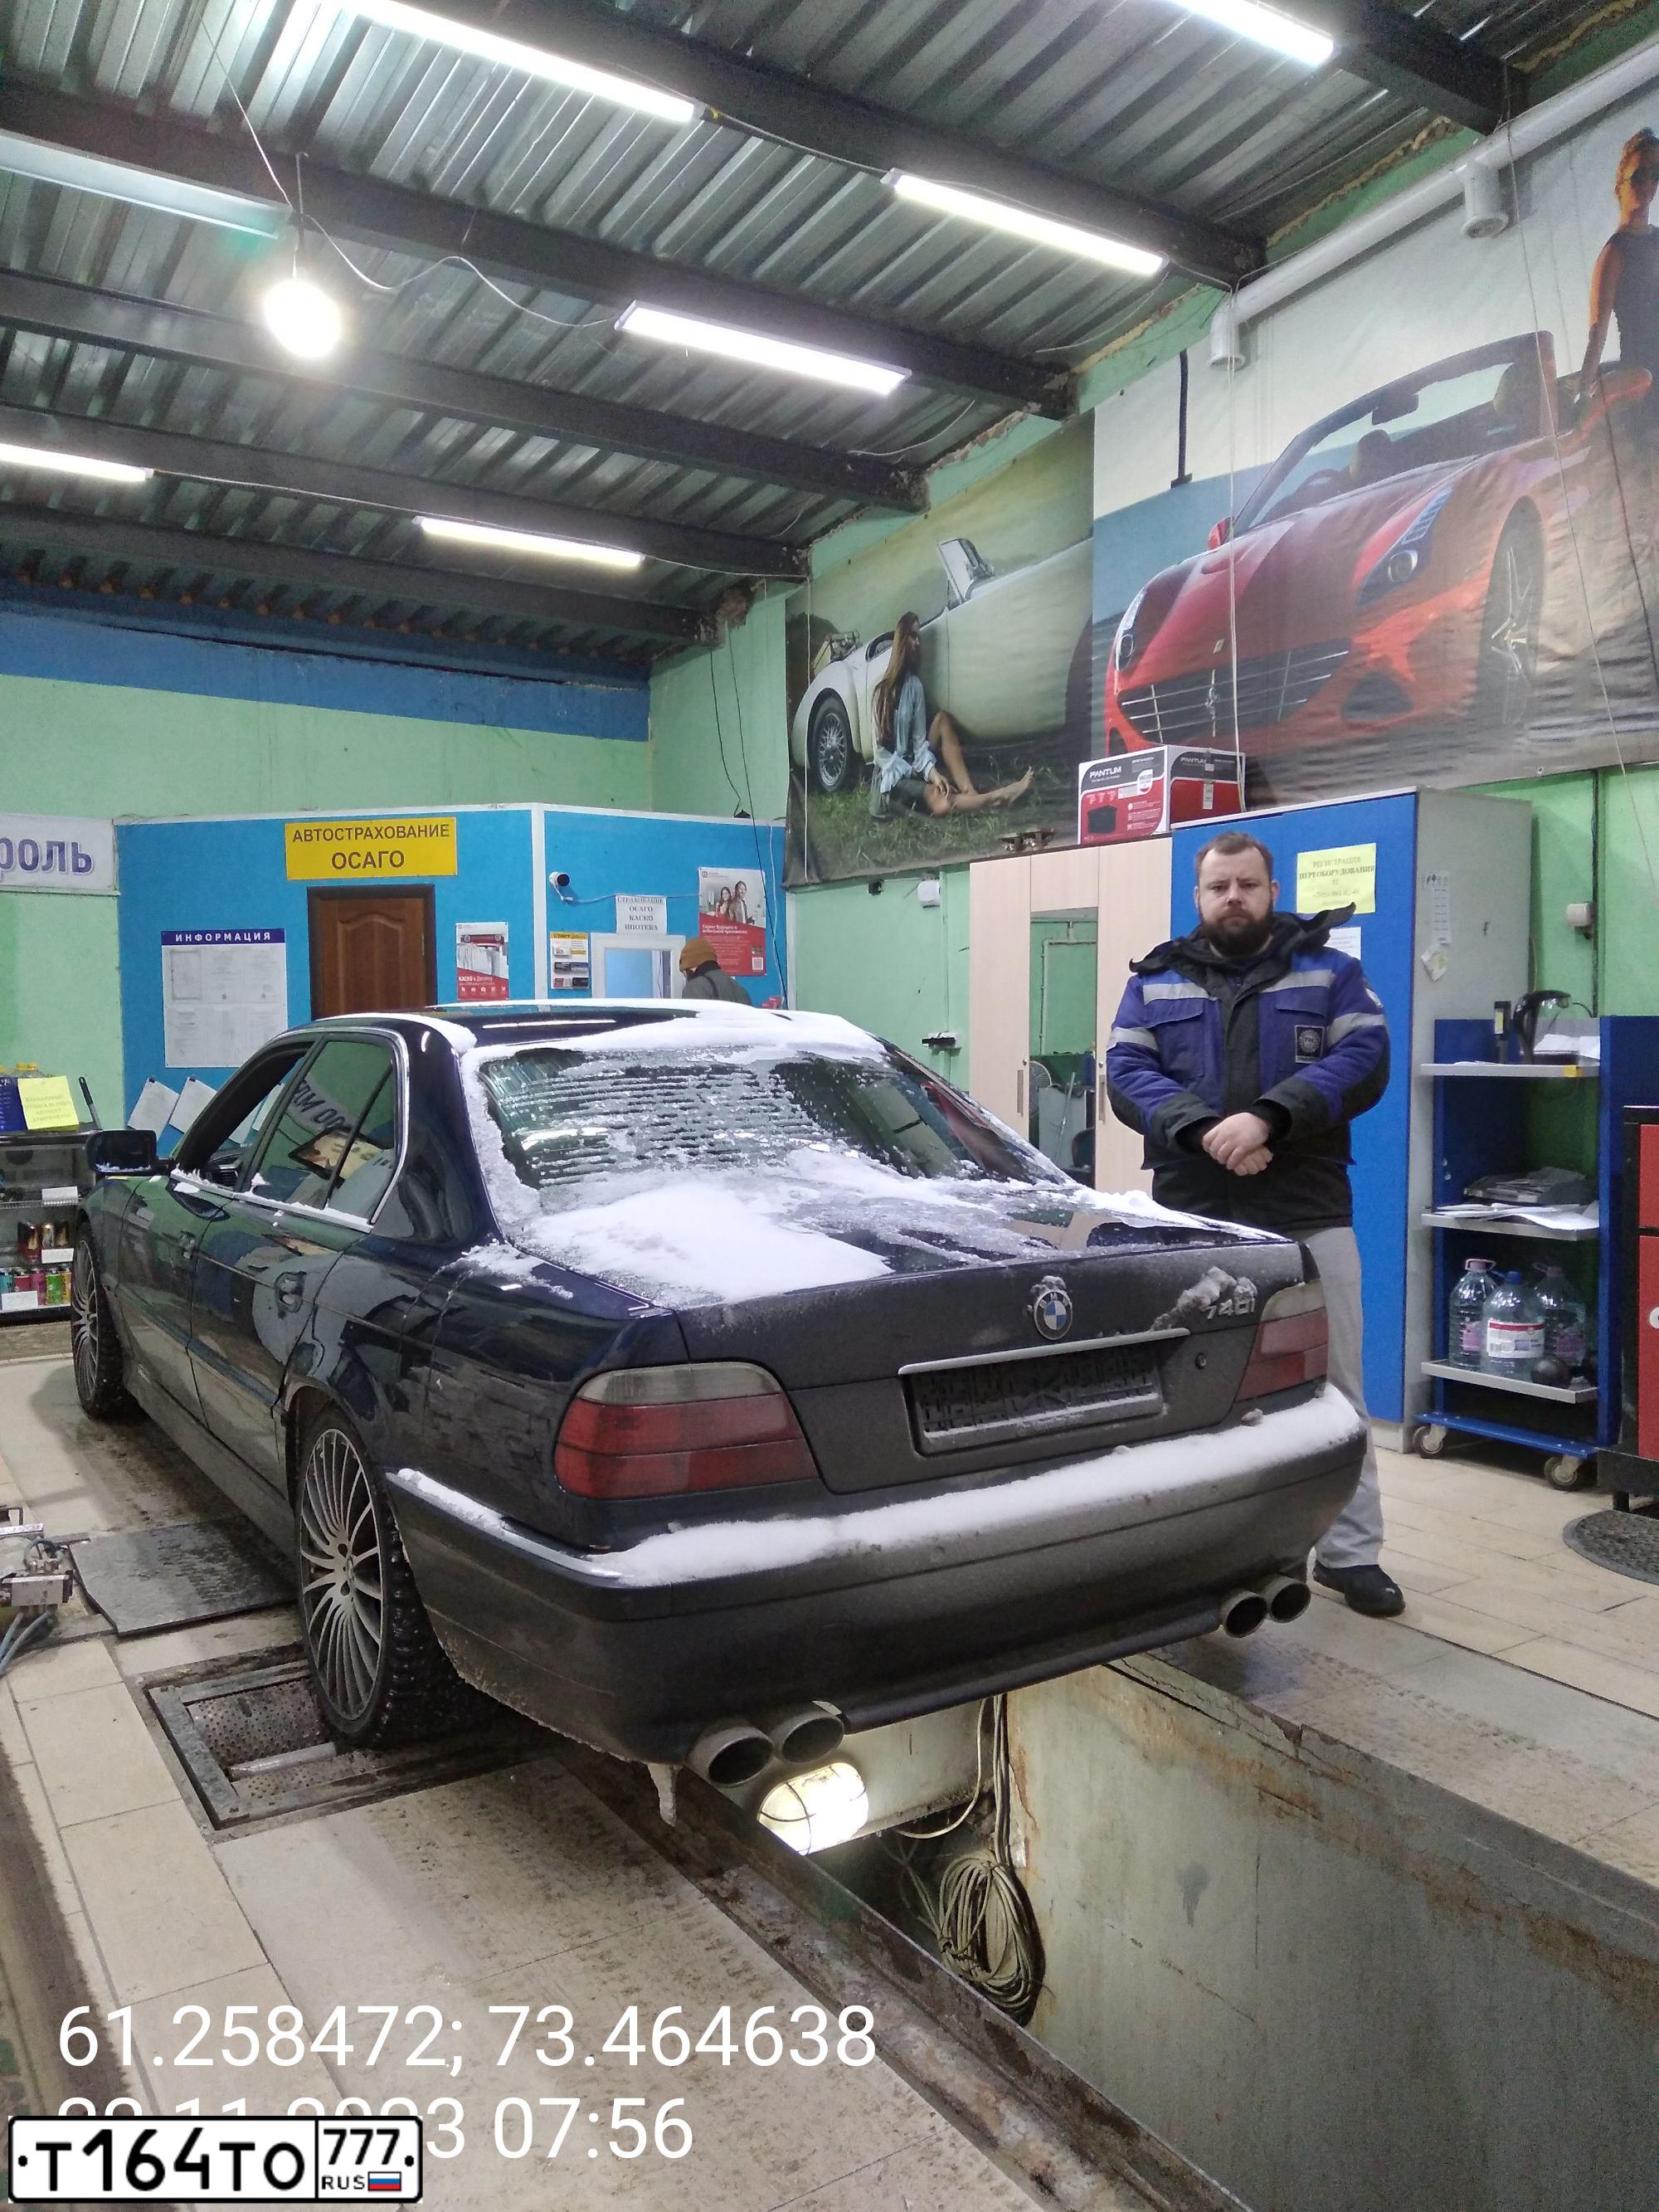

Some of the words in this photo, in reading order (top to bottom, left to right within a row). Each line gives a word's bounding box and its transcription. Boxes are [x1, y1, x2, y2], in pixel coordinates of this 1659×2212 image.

[1089, 766, 1122, 779] PANTUM
[293, 824, 450, 842] АВТОСТРАХОВАНИЕ
[331, 850, 405, 870] ОСАГО
[1299, 865, 1375, 879] ПЕРЕОБОРУДОВАНИЯ
[617, 896, 664, 904] СТРАХОВАНИЕ
[175, 932, 271, 943] ИНФОРМАЦИЯ
[1039, 1292, 1069, 1309] BMW
